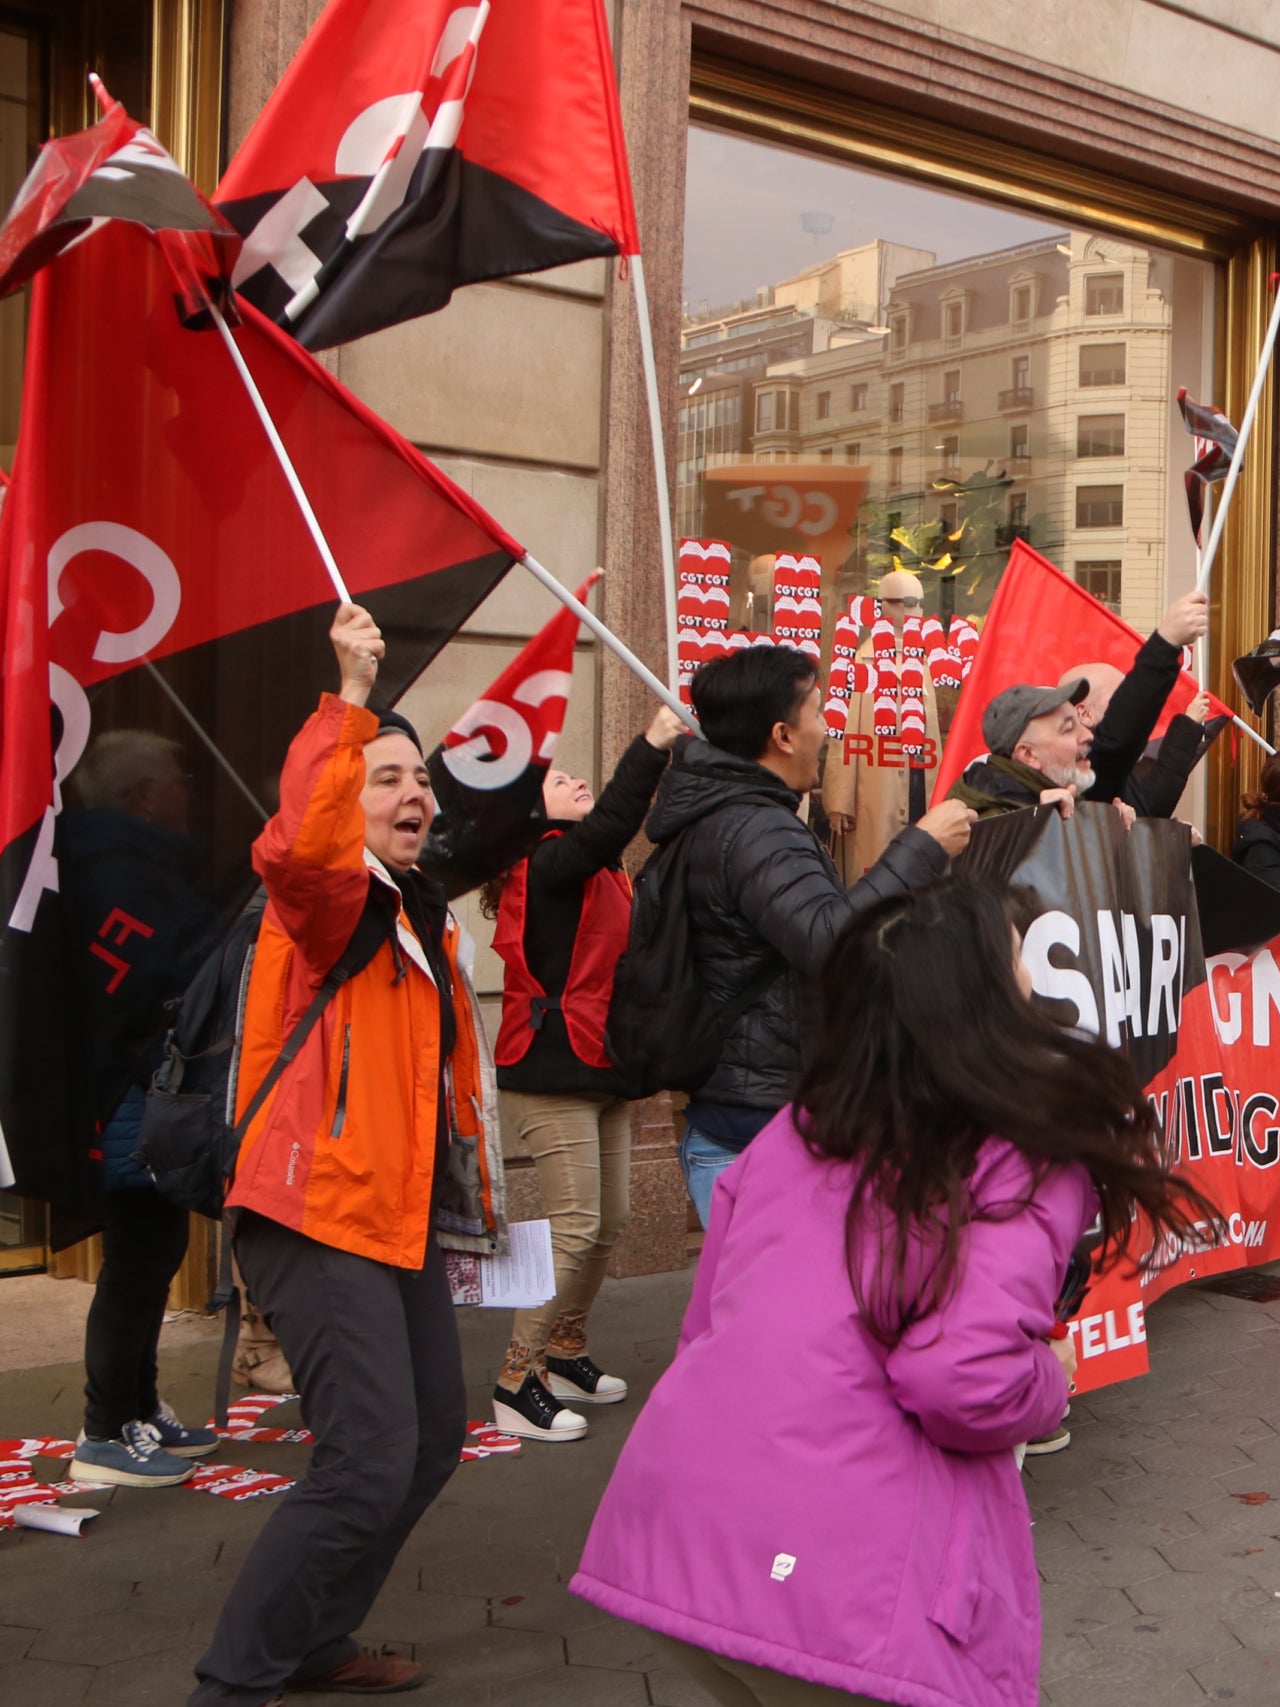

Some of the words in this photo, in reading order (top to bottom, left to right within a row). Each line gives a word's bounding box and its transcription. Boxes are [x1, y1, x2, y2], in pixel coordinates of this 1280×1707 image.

[680, 572, 704, 584] CGT
[705, 574, 729, 586] CGT
[775, 584, 797, 596] CGT
[797, 586, 820, 598] CGT
[679, 614, 702, 627] CGT
[704, 617, 728, 630] CGT
[775, 626, 798, 638] CGT
[798, 627, 820, 639] CGT
[834, 644, 856, 658] CGT
[904, 646, 925, 658] CGT
[829, 686, 851, 699] CGT
[902, 686, 923, 697] CGT
[875, 725, 897, 736] CGT
[902, 744, 923, 755] CGT
[286, 1150, 300, 1186] Columbia
